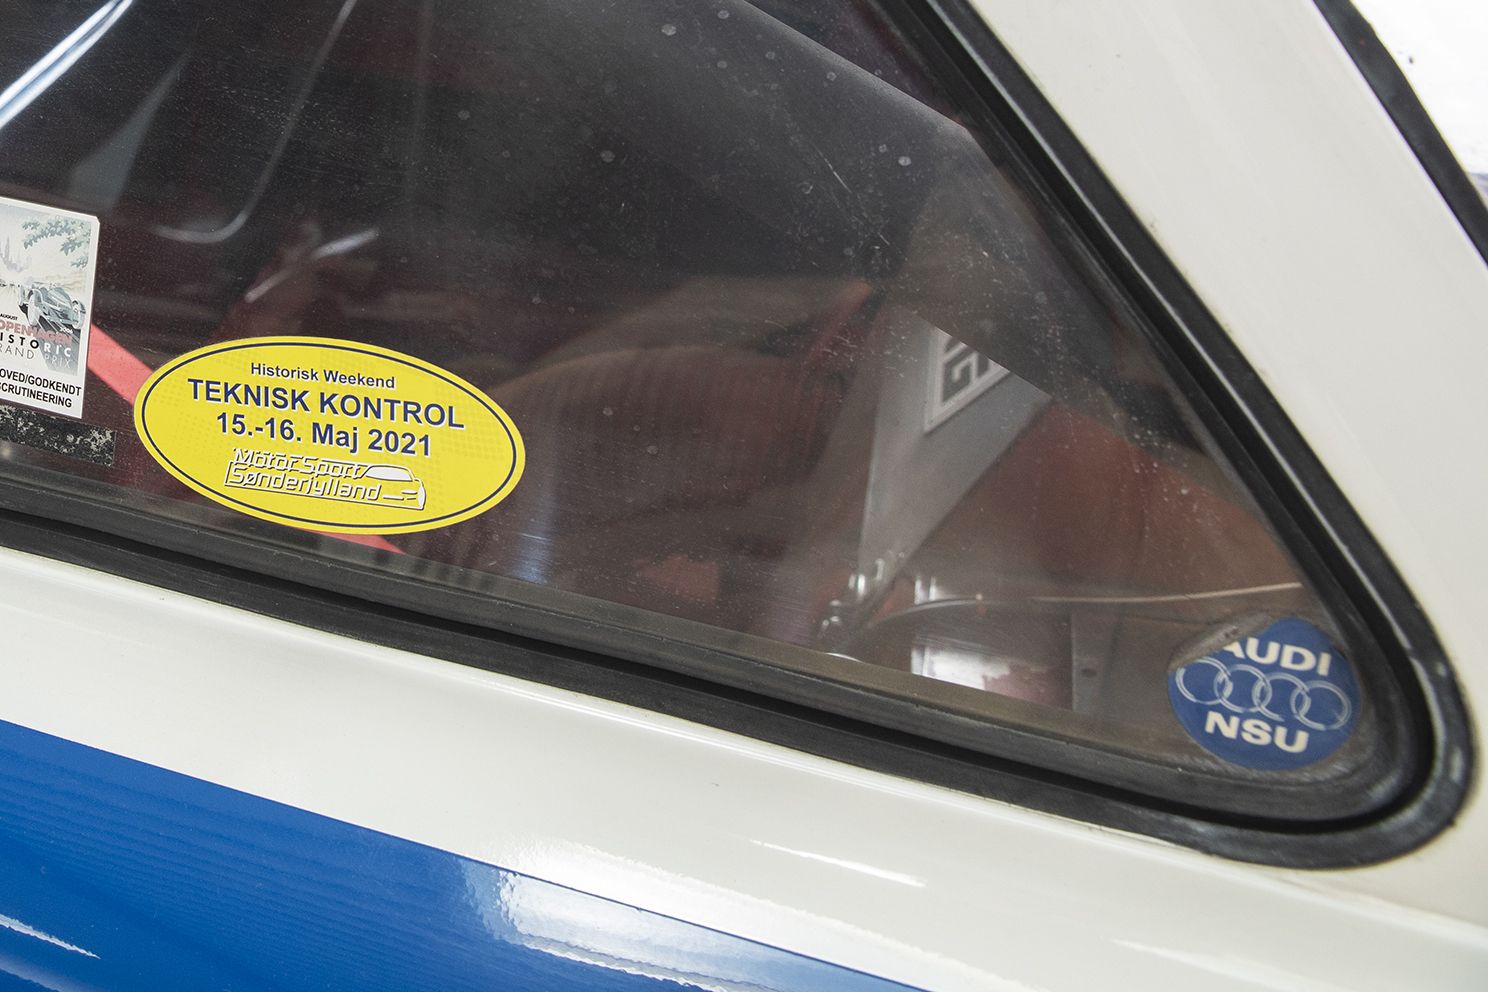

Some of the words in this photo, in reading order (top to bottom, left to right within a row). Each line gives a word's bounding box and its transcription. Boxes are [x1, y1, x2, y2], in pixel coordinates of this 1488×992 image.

[0, 313, 18, 321] AUGUST
[44, 353, 72, 369] PRIX
[250, 362, 319, 381] Historisk
[323, 369, 395, 389] Weekend
[187, 378, 311, 413] TEKNISK
[319, 391, 466, 430] KONTROL
[216, 412, 302, 443] 15.-16.
[311, 421, 360, 454] Maj
[368, 428, 431, 457] 2021
[229, 466, 383, 502] Sønderjylland
[1204, 710, 1310, 754] NSU
